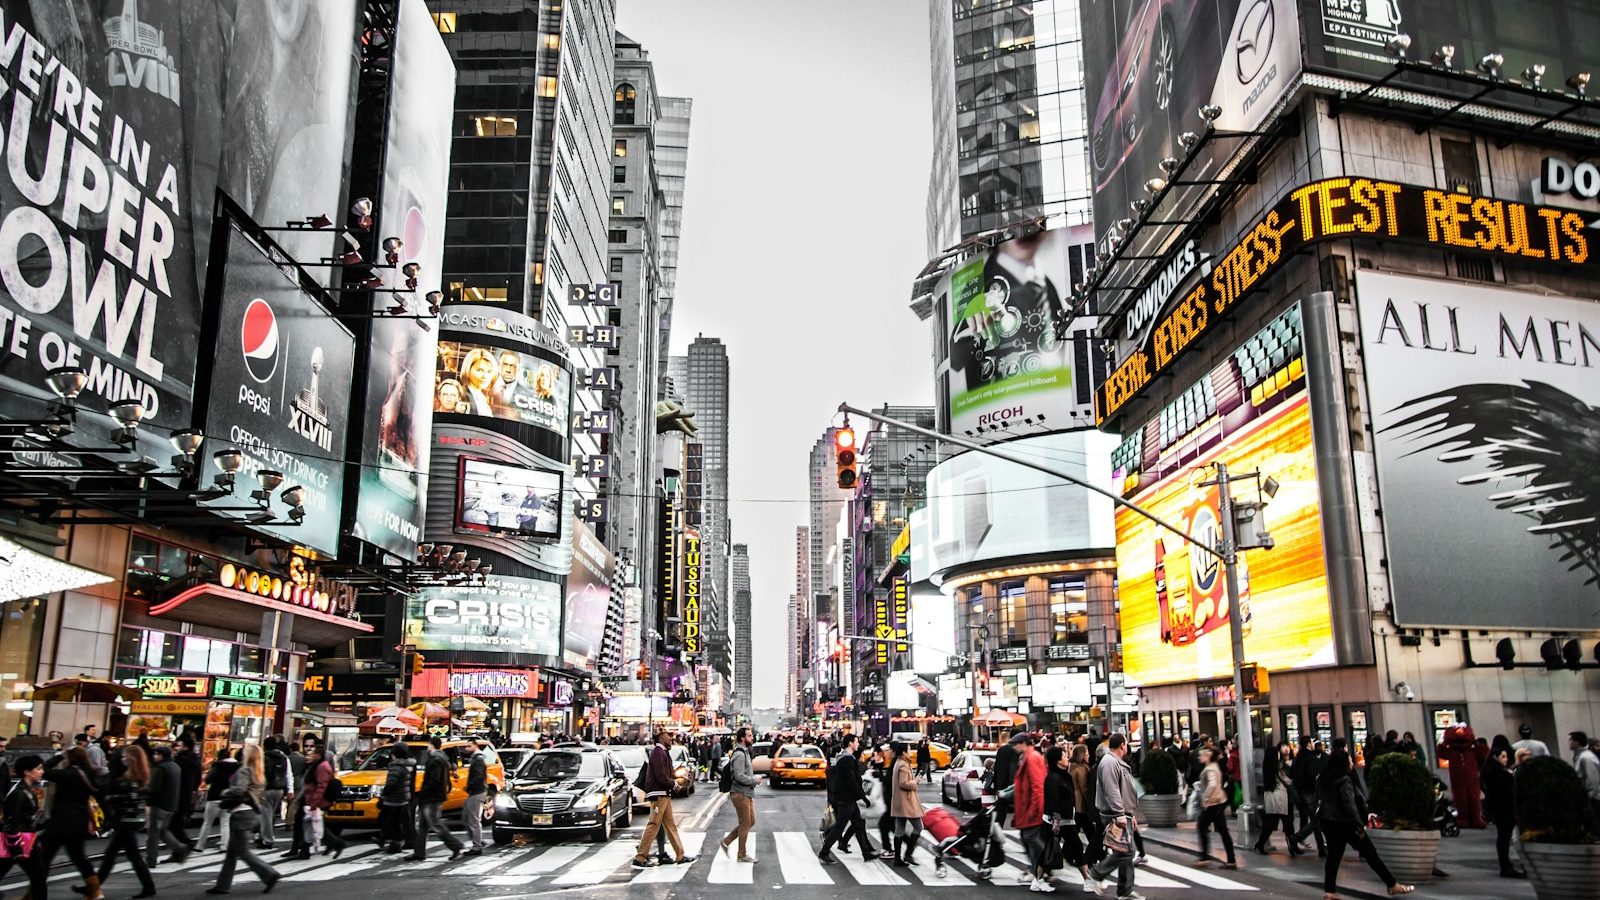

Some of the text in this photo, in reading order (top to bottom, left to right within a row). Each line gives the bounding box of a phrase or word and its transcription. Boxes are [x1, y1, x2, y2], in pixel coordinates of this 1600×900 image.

[1327, 8, 1361, 21] HIGHWAY
[1329, 23, 1347, 34] EPA
[133, 44, 158, 57] BOWL
[1242, 64, 1277, 115] mazda
[110, 114, 151, 186] IN
[156, 163, 180, 216] A
[0, 73, 175, 298] UPER
[1105, 348, 1152, 417] RESERVE
[1153, 284, 1208, 371] REVISES
[1424, 190, 1588, 264] RESULTS
[1372, 297, 1477, 354] ALL
[39, 331, 82, 371] OF
[86, 355, 159, 419] MIND
[239, 384, 271, 416] pepsi
[514, 394, 565, 421] CRISIS
[288, 404, 332, 452] XLVIII
[979, 406, 1024, 426] RICOH
[231, 425, 329, 489] OFFICIAL SOFT DRINK OF
[385, 510, 400, 533] FOR
[401, 518, 419, 543] NOW
[441, 586, 479, 595] protect
[481, 586, 498, 595] the
[502, 581, 519, 590] you
[425, 599, 550, 631] CRISIS
[895, 579, 907, 624] VICTORY
[451, 634, 499, 645] SUNDAYS
[877, 643, 887, 663] NEW
[143, 679, 180, 694] SODA
[230, 681, 261, 698] RICE
[450, 672, 528, 694] CHAMPS
[133, 703, 206, 712] HALAL FOOD
